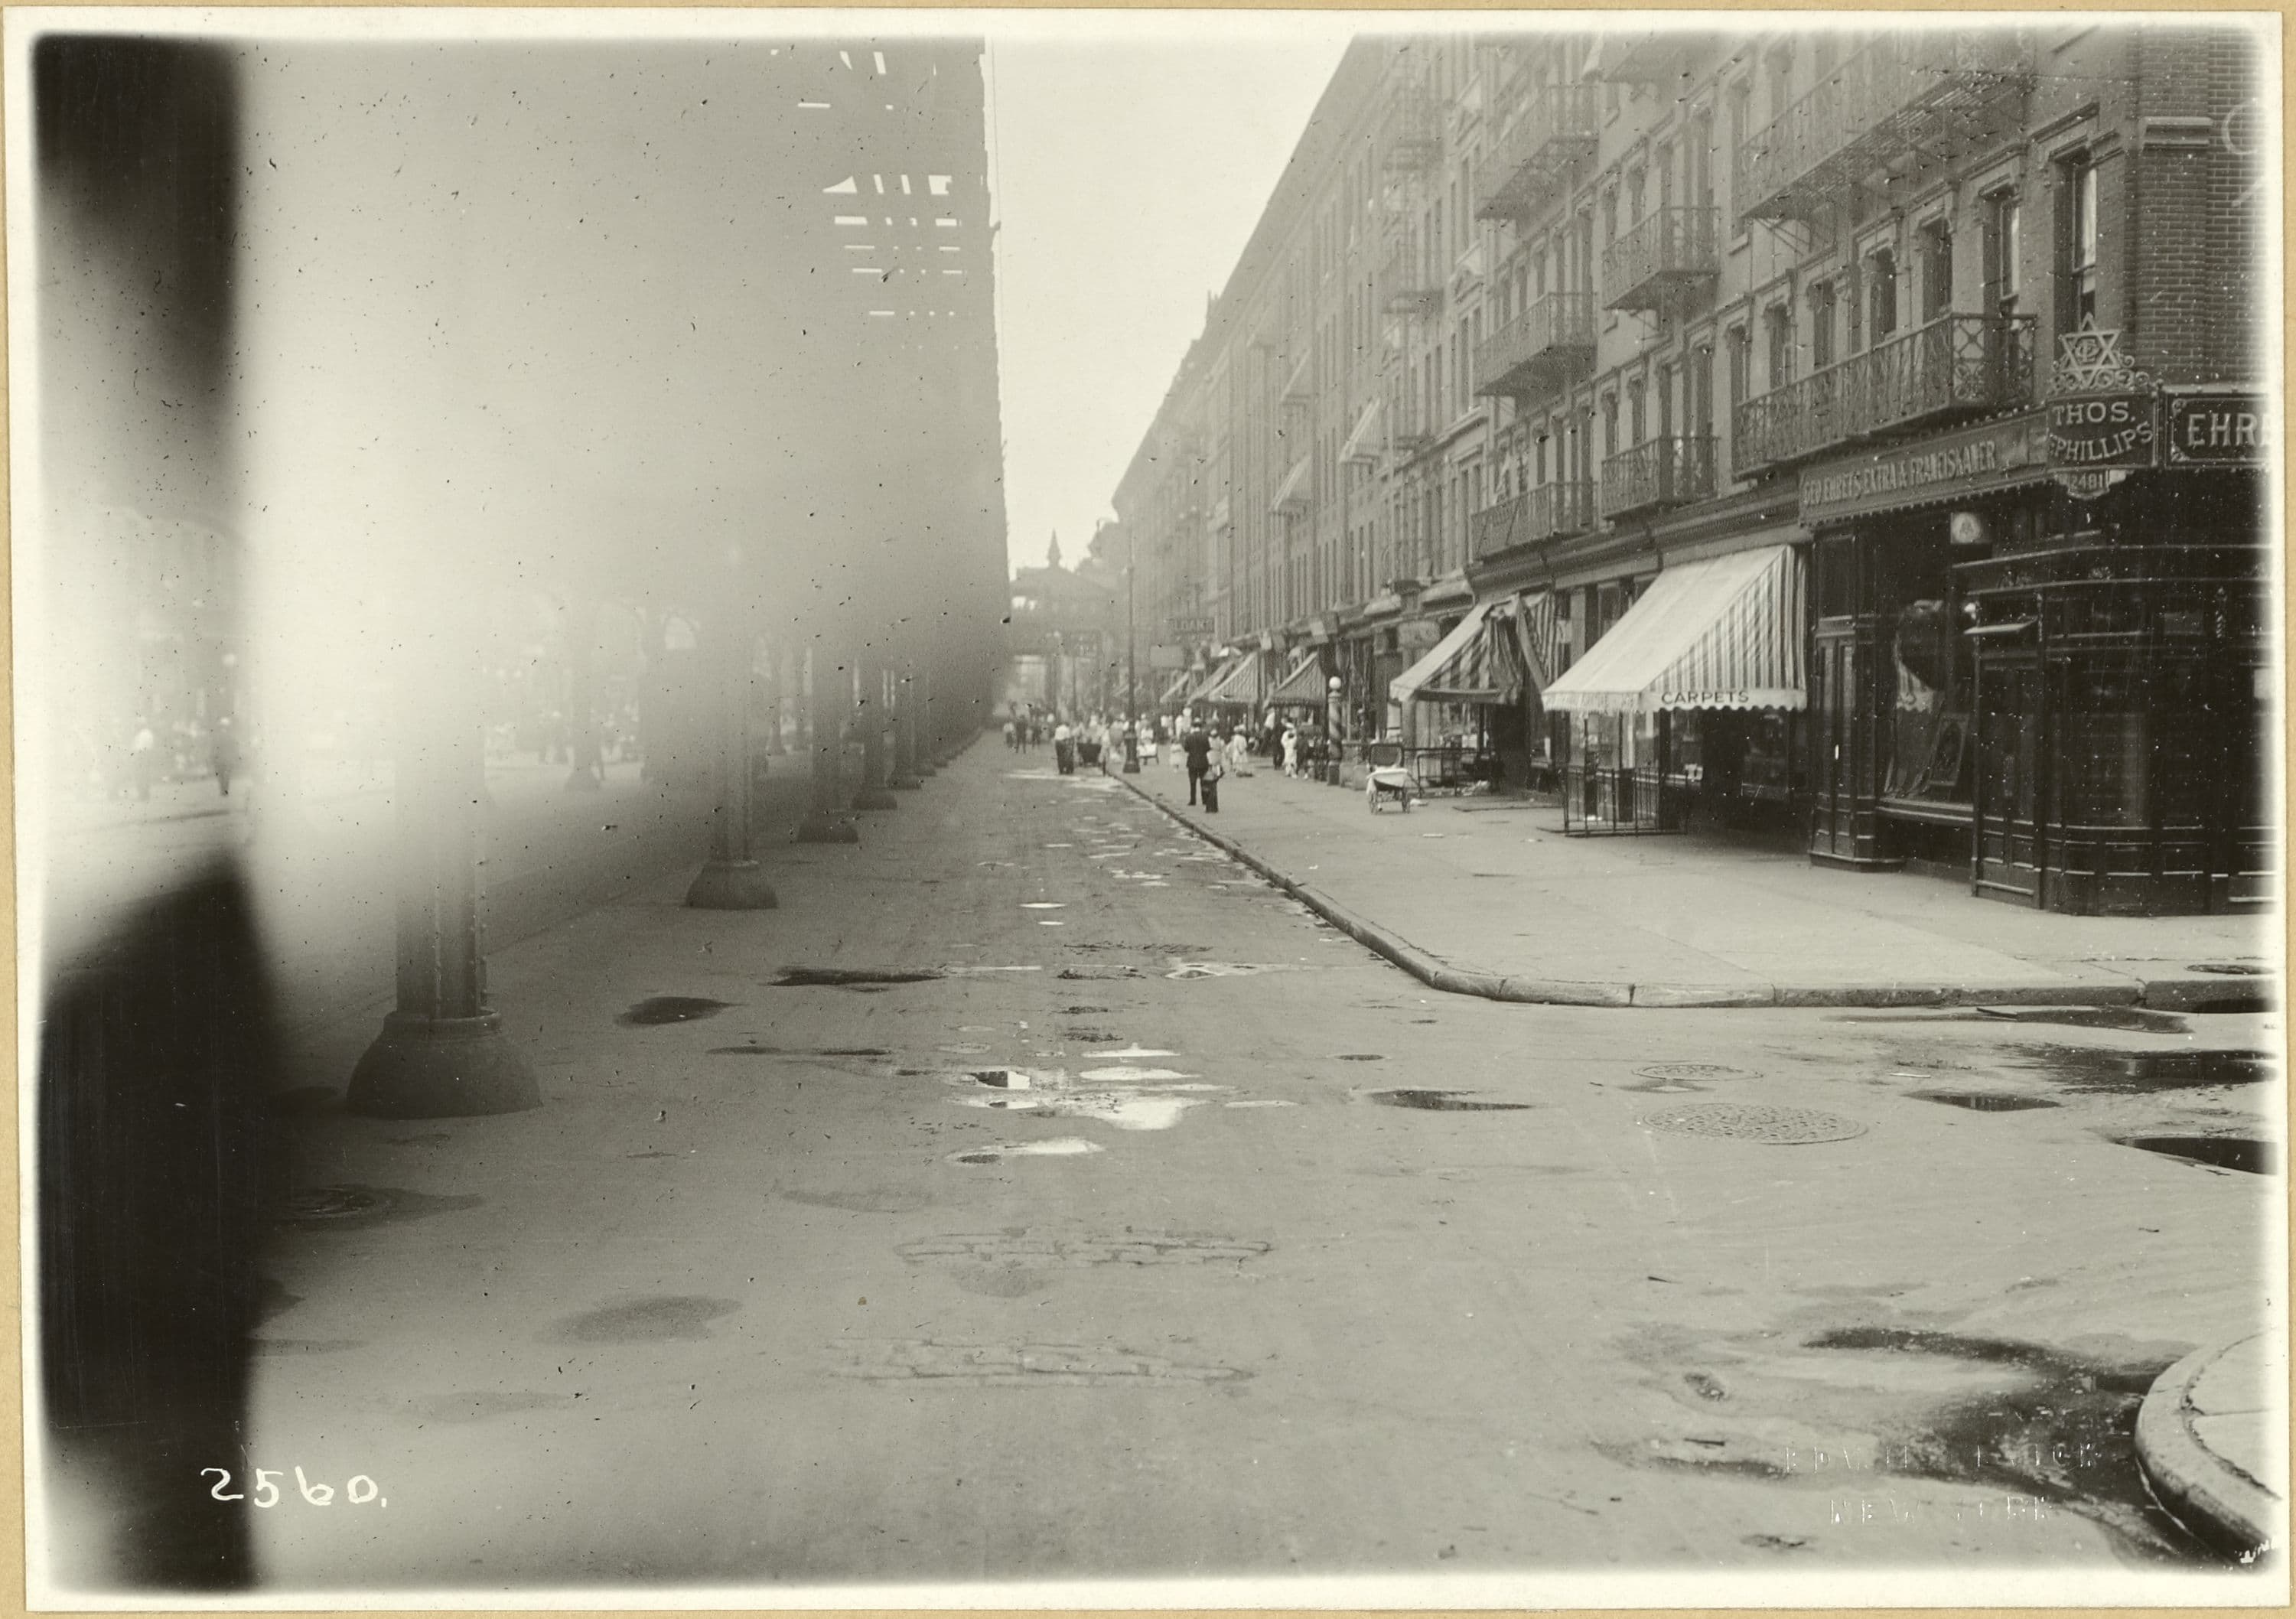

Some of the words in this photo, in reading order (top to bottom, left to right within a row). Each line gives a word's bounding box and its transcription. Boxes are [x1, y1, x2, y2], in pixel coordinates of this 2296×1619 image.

[2052, 401, 2135, 426] THOS.
[2053, 421, 2154, 461] PHILLIPS
[2070, 472, 2103, 490] 2481
[1661, 690, 1749, 704] CARPETS
